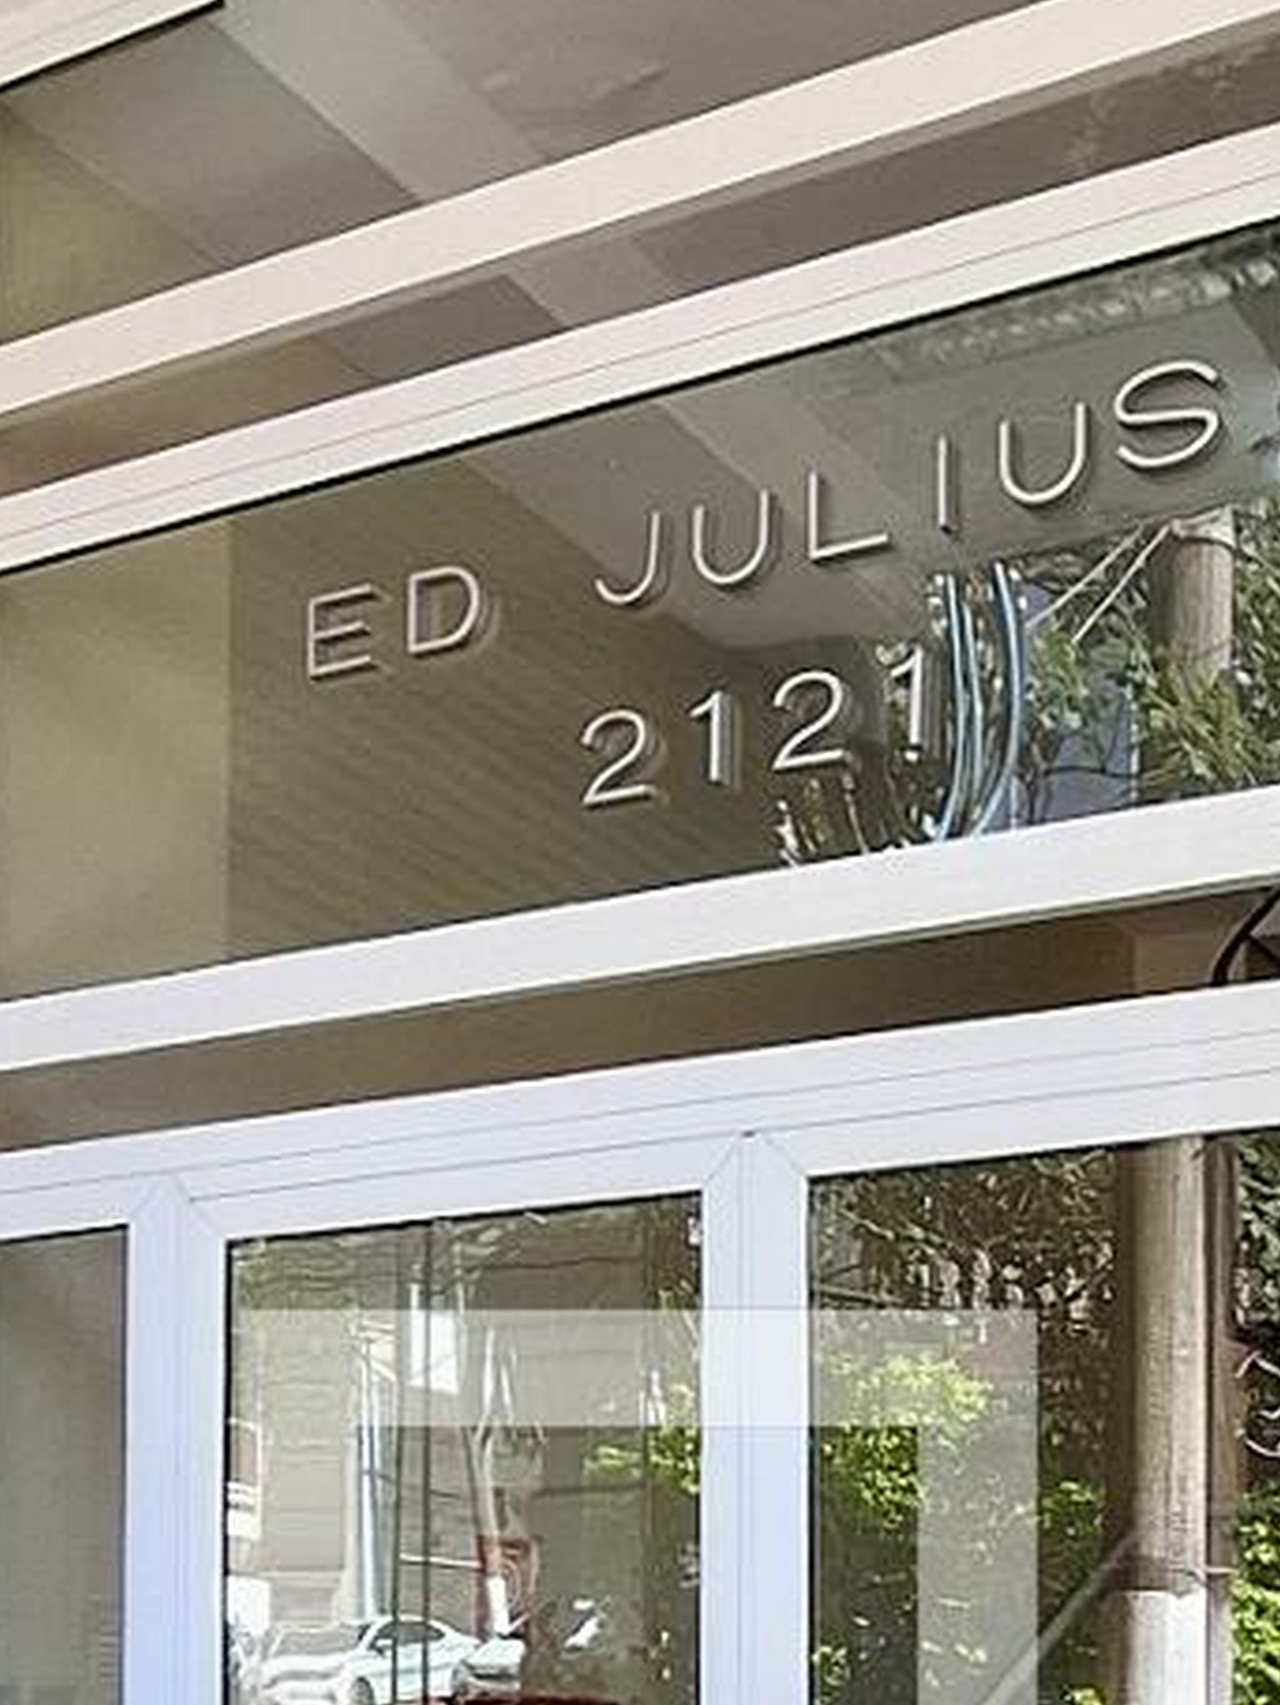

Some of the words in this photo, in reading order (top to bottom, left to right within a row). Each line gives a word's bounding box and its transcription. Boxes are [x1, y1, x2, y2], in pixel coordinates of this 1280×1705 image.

[305, 565, 485, 682] ED
[592, 360, 1226, 608] JULIUS
[579, 645, 925, 810] 2121
